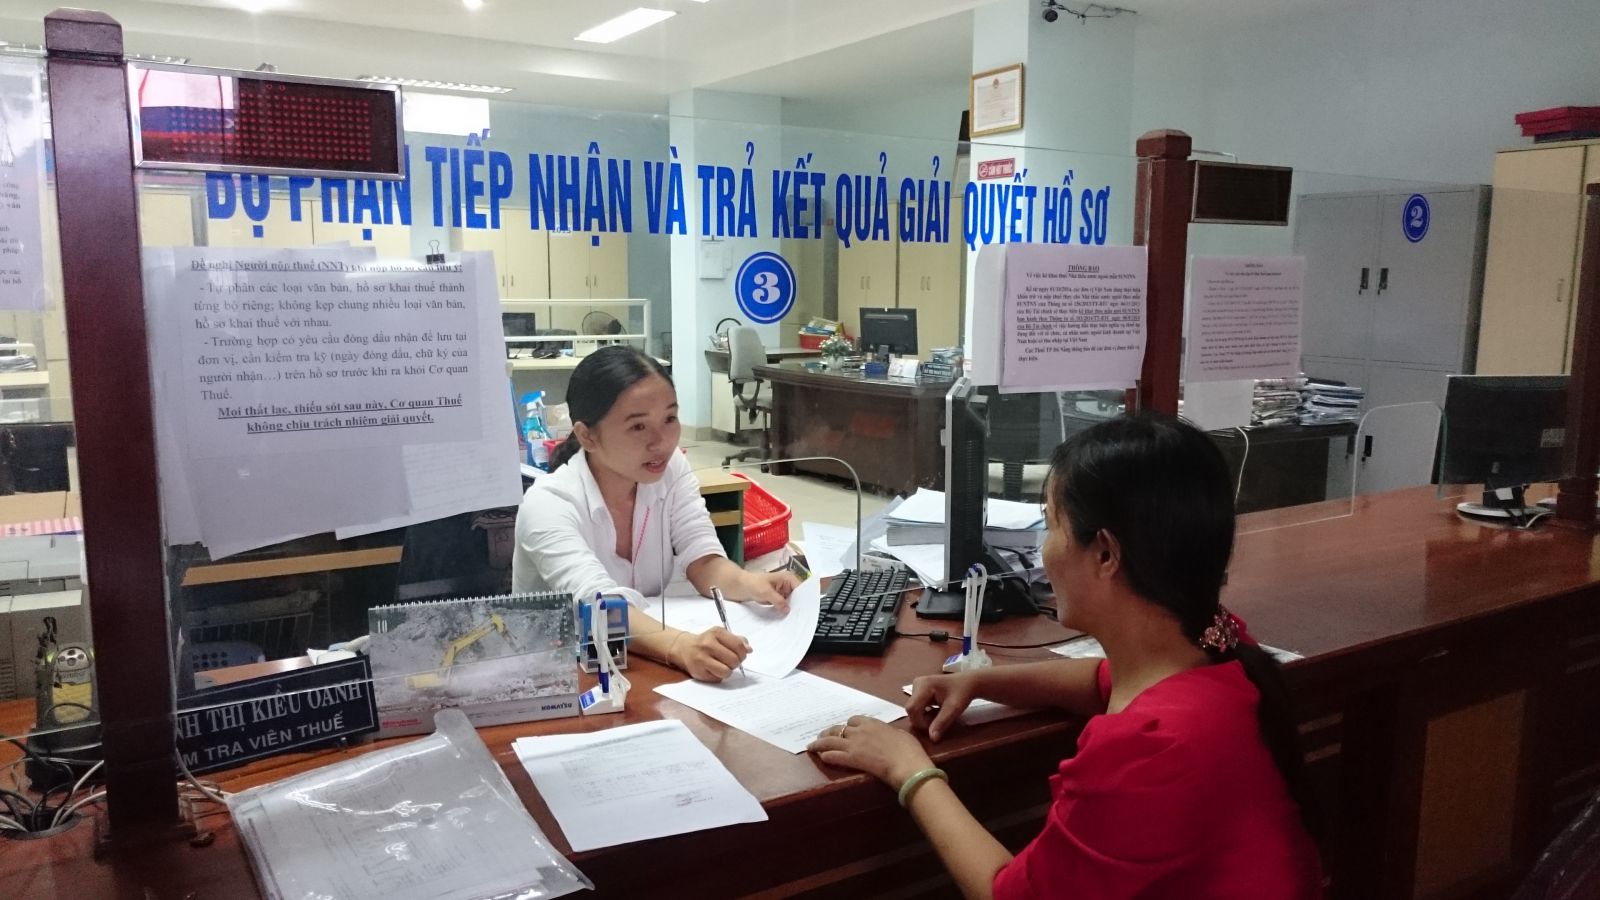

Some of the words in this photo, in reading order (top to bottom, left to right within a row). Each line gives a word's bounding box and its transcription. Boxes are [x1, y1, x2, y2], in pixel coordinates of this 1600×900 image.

[425, 128, 513, 231] TIẾP
[528, 141, 632, 247] NHẬN
[643, 145, 688, 237] VÀ
[697, 141, 758, 238] TRẢ
[771, 152, 826, 240] KẾT
[835, 151, 890, 248] QUẢ
[900, 155, 951, 244] GIẢI
[963, 168, 1037, 251] QUYẾT
[1043, 169, 1075, 244] HỒ
[1080, 186, 1111, 245] SƠ
[1410, 205, 1424, 228] 2
[191, 257, 206, 271] Đề
[235, 260, 267, 272] Người
[270, 260, 290, 272] nộp
[293, 259, 315, 272] thuế
[228, 282, 254, 294] phân
[260, 282, 278, 292] các
[282, 281, 303, 293] loại
[307, 282, 326, 292] văn
[356, 281, 370, 292] hồ
[373, 284, 385, 292] sơ
[389, 282, 411, 292] khai
[414, 280, 436, 292] thuế
[439, 282, 465, 292] thành
[751, 271, 782, 304] 3
[193, 301, 220, 314] từng
[242, 301, 274, 313] riêng;
[279, 300, 312, 312] không
[315, 300, 334, 313] kẹp
[337, 300, 369, 312] chung
[372, 297, 400, 309] nhiều
[404, 299, 422, 311] loại
[425, 300, 443, 309] văn
[195, 316, 210, 329] hồ
[213, 319, 226, 328] sơ
[229, 318, 253, 329] khai
[256, 316, 280, 328] thuế
[283, 318, 300, 327] với
[304, 317, 332, 328] nhau.
[211, 336, 252, 348] Trường
[257, 336, 278, 348] hợp
[282, 336, 295, 345] có
[299, 335, 318, 347] yêu
[321, 331, 340, 344] cầu
[343, 333, 369, 346] đóng
[372, 331, 391, 343] dấu
[394, 332, 419, 344] nhận
[421, 330, 433, 342] để
[437, 332, 452, 341] lưu
[455, 331, 467, 342] tại
[198, 355, 220, 365] đơn
[242, 352, 262, 364] cần
[265, 352, 292, 364] kiểm
[296, 354, 310, 362] tra
[314, 352, 328, 363] kỹ
[330, 351, 360, 363] (ngày
[362, 350, 388, 362] đóng
[415, 348, 433, 358] chữ
[437, 348, 449, 359] ký
[451, 348, 468, 357] của
[199, 372, 232, 385] người
[284, 370, 306, 380] trên
[309, 366, 323, 379] hồ
[341, 367, 368, 377] trước
[371, 366, 387, 377] khi
[404, 365, 425, 375] khỏi
[428, 365, 443, 374] Cơ
[446, 366, 468, 376] quan
[200, 387, 233, 401] Thuế.
[218, 406, 241, 418] Mọi
[245, 403, 268, 415] thất
[294, 400, 322, 413] thiếu
[325, 402, 341, 412] sót
[343, 403, 362, 411] sau
[365, 400, 387, 410] này,
[390, 398, 406, 409] Cơ
[408, 399, 434, 409] quan
[436, 393, 463, 406] Thuế
[247, 421, 284, 433] không
[286, 419, 310, 431] chịu
[313, 417, 342, 429] trách
[345, 414, 378, 427] nhiệm
[381, 413, 400, 426] giải
[402, 410, 435, 424] quyết.
[206, 703, 247, 732] THỊ
[252, 683, 302, 723] KIỀU
[307, 678, 364, 709] OANH
[204, 744, 244, 761] TRA
[249, 729, 293, 750] VIÊN
[295, 710, 345, 738] THUẾ
